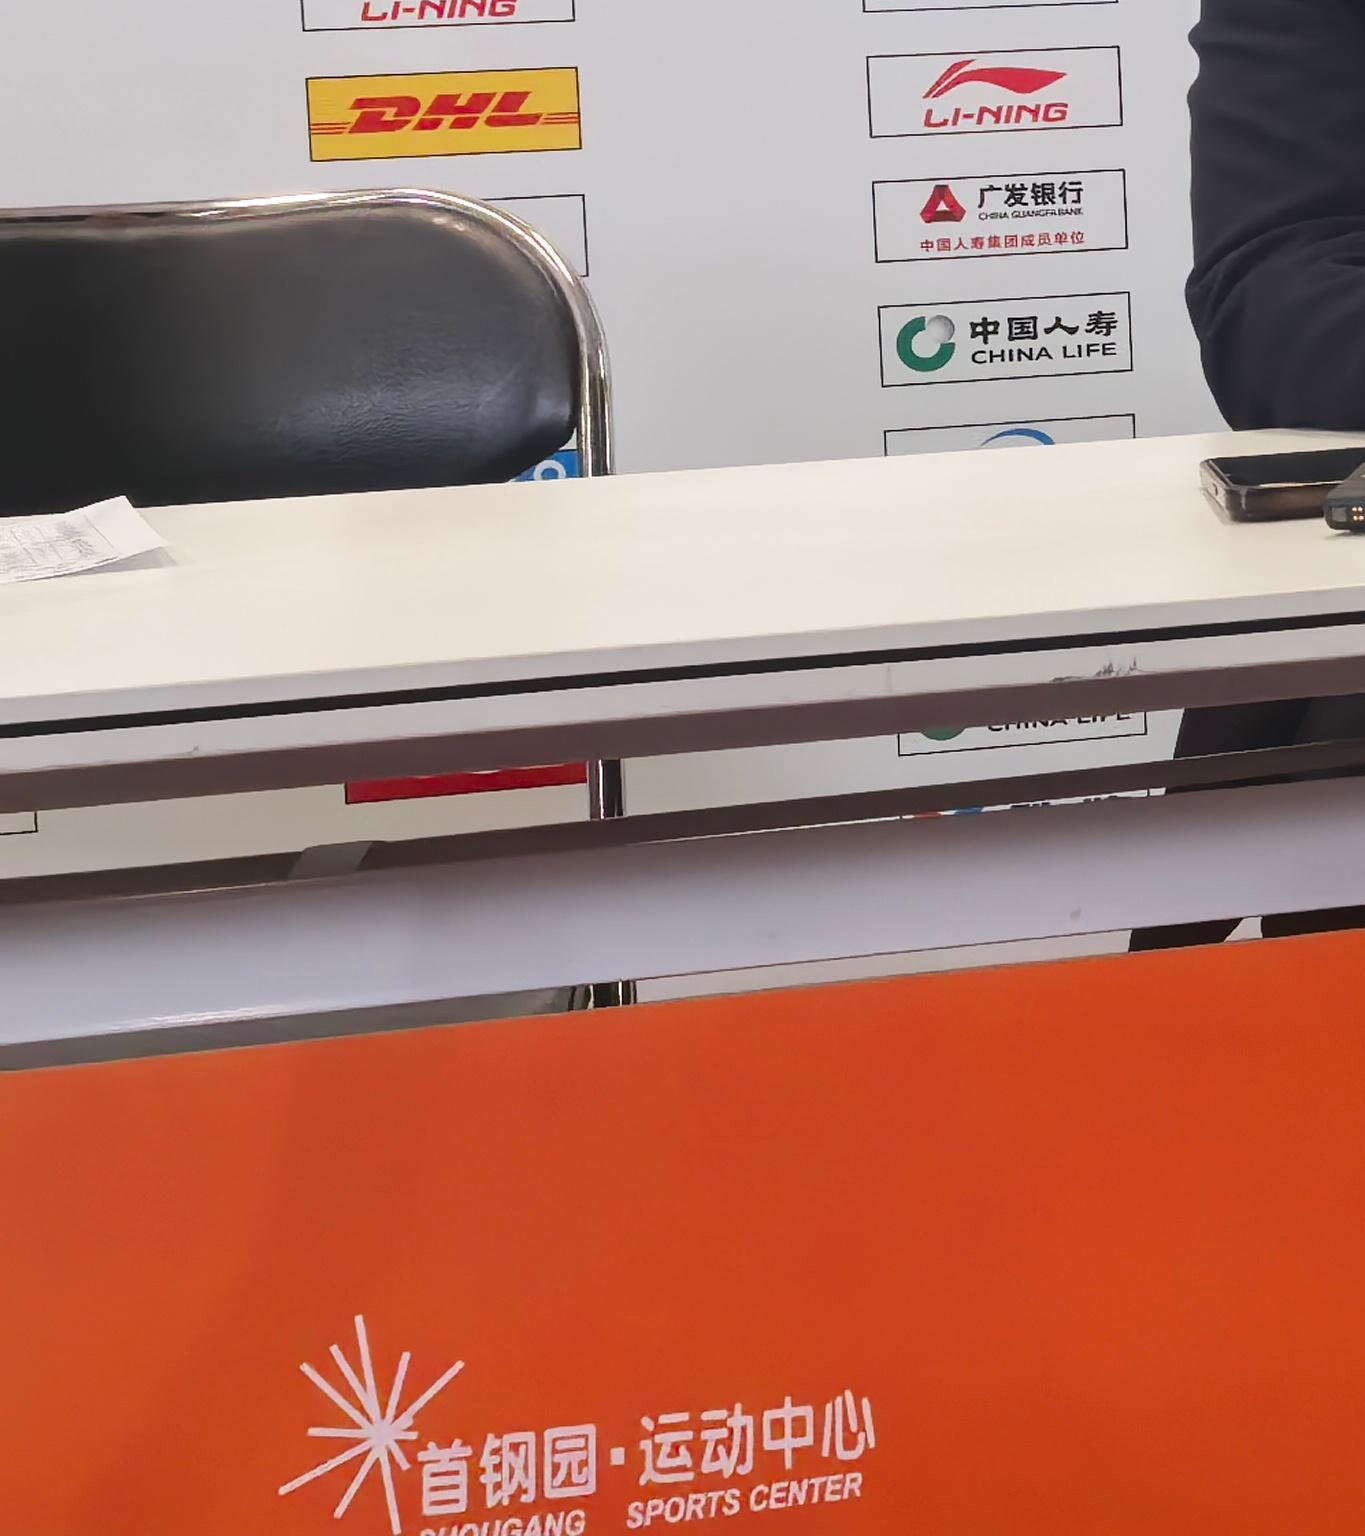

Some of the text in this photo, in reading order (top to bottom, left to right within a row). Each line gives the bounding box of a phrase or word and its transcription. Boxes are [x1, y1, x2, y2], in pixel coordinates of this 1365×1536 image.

[346, 89, 543, 134] DHL
[922, 102, 1070, 128] LI-NING
[977, 179, 1083, 210] 广发银行
[968, 309, 1118, 346] 中国人寿
[971, 341, 1117, 365] CHINA LIFE
[418, 1389, 876, 1516] 首钢园·运动中心
[625, 1472, 863, 1530] SPORTS CENTER
